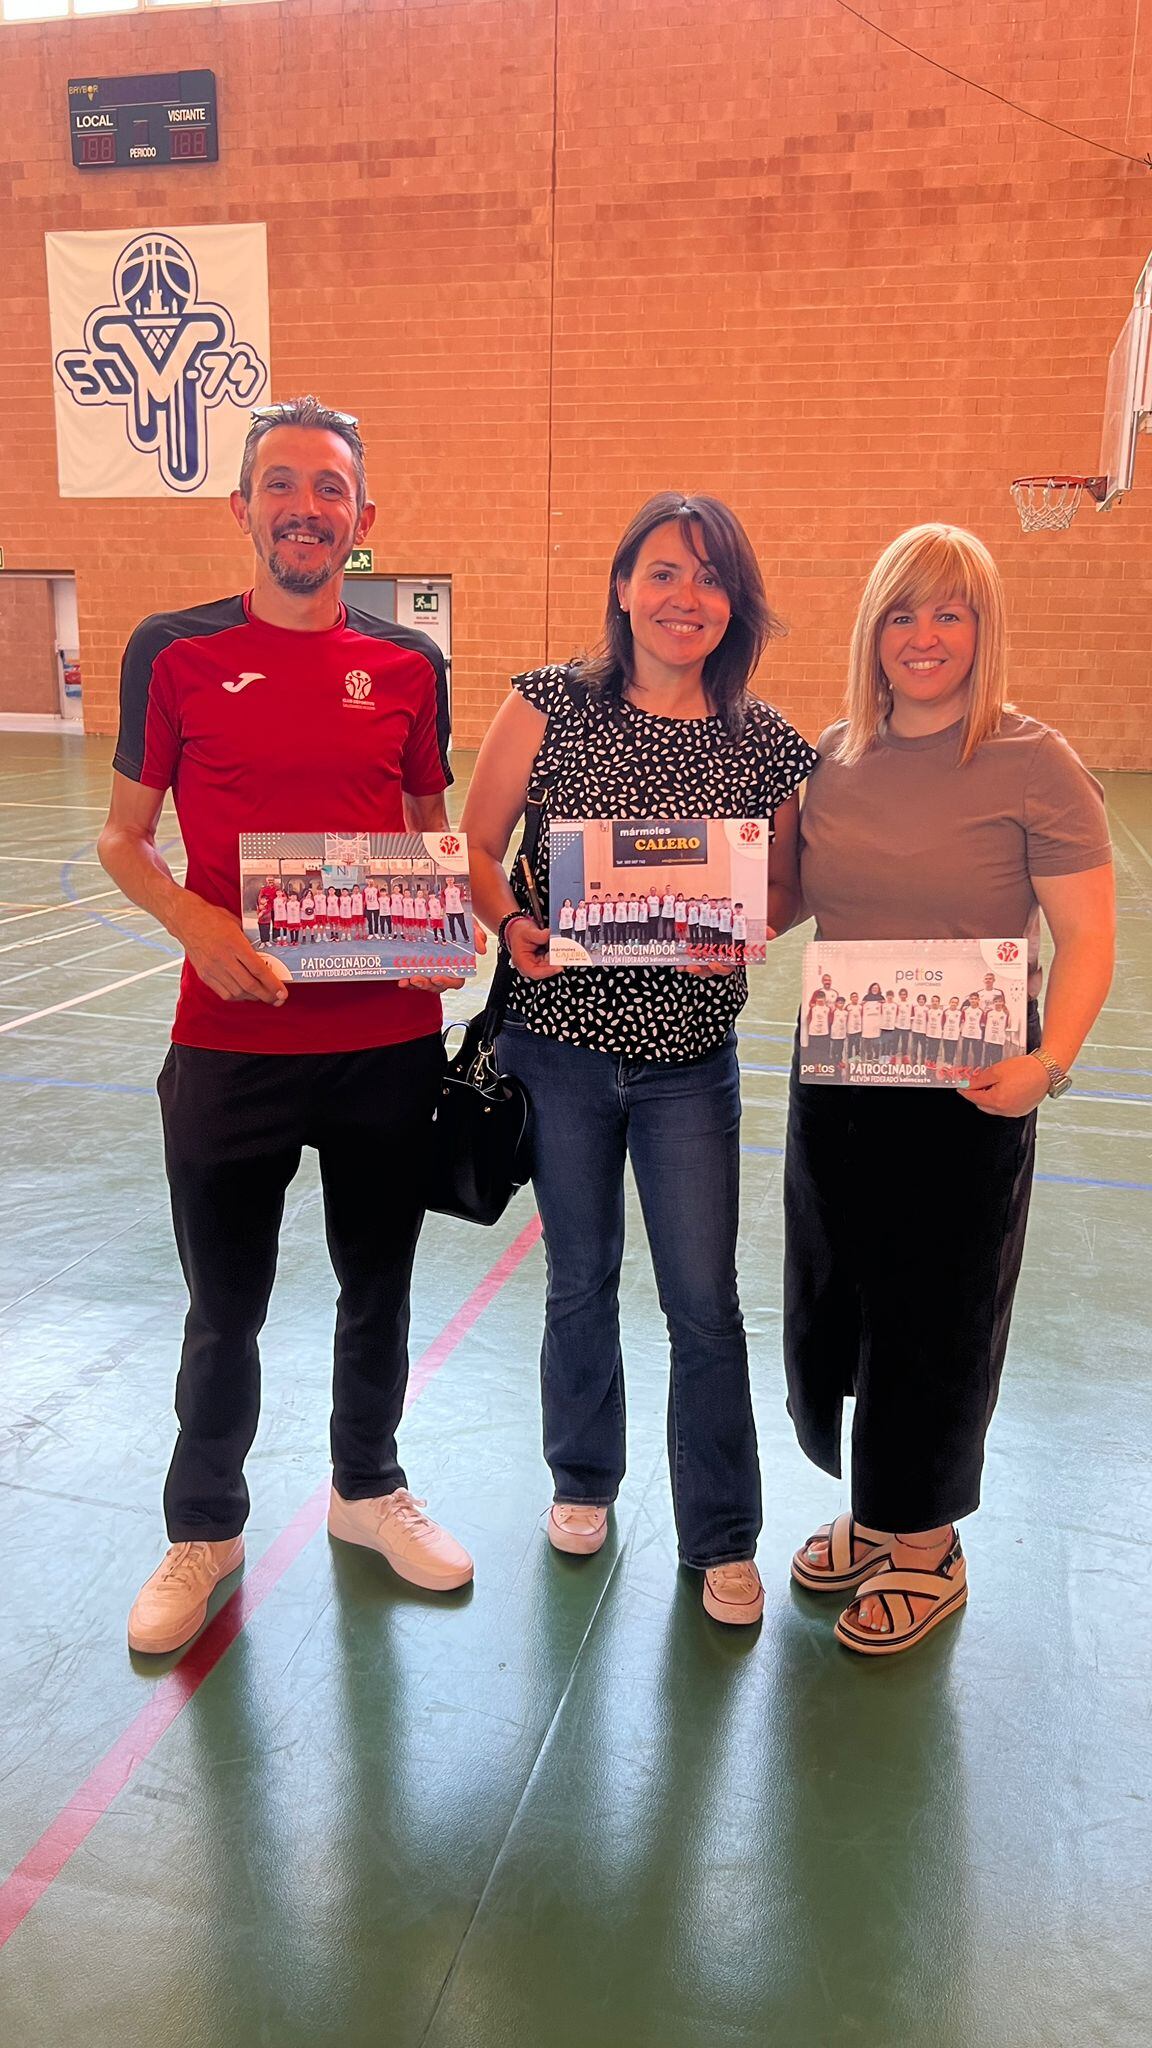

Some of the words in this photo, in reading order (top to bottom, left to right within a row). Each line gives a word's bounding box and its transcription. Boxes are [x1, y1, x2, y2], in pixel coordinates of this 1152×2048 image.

[76, 115, 114, 128] LOCAL
[167, 108, 206, 122] VISITANTE
[129, 147, 157, 159] PERIODO
[620, 826, 671, 837] mármoles
[634, 837, 701, 851] CALERO
[601, 944, 676, 957] PATROCINADOR
[301, 956, 381, 970] PATROCINADOR
[849, 1063, 927, 1076] PATROCINADOR
